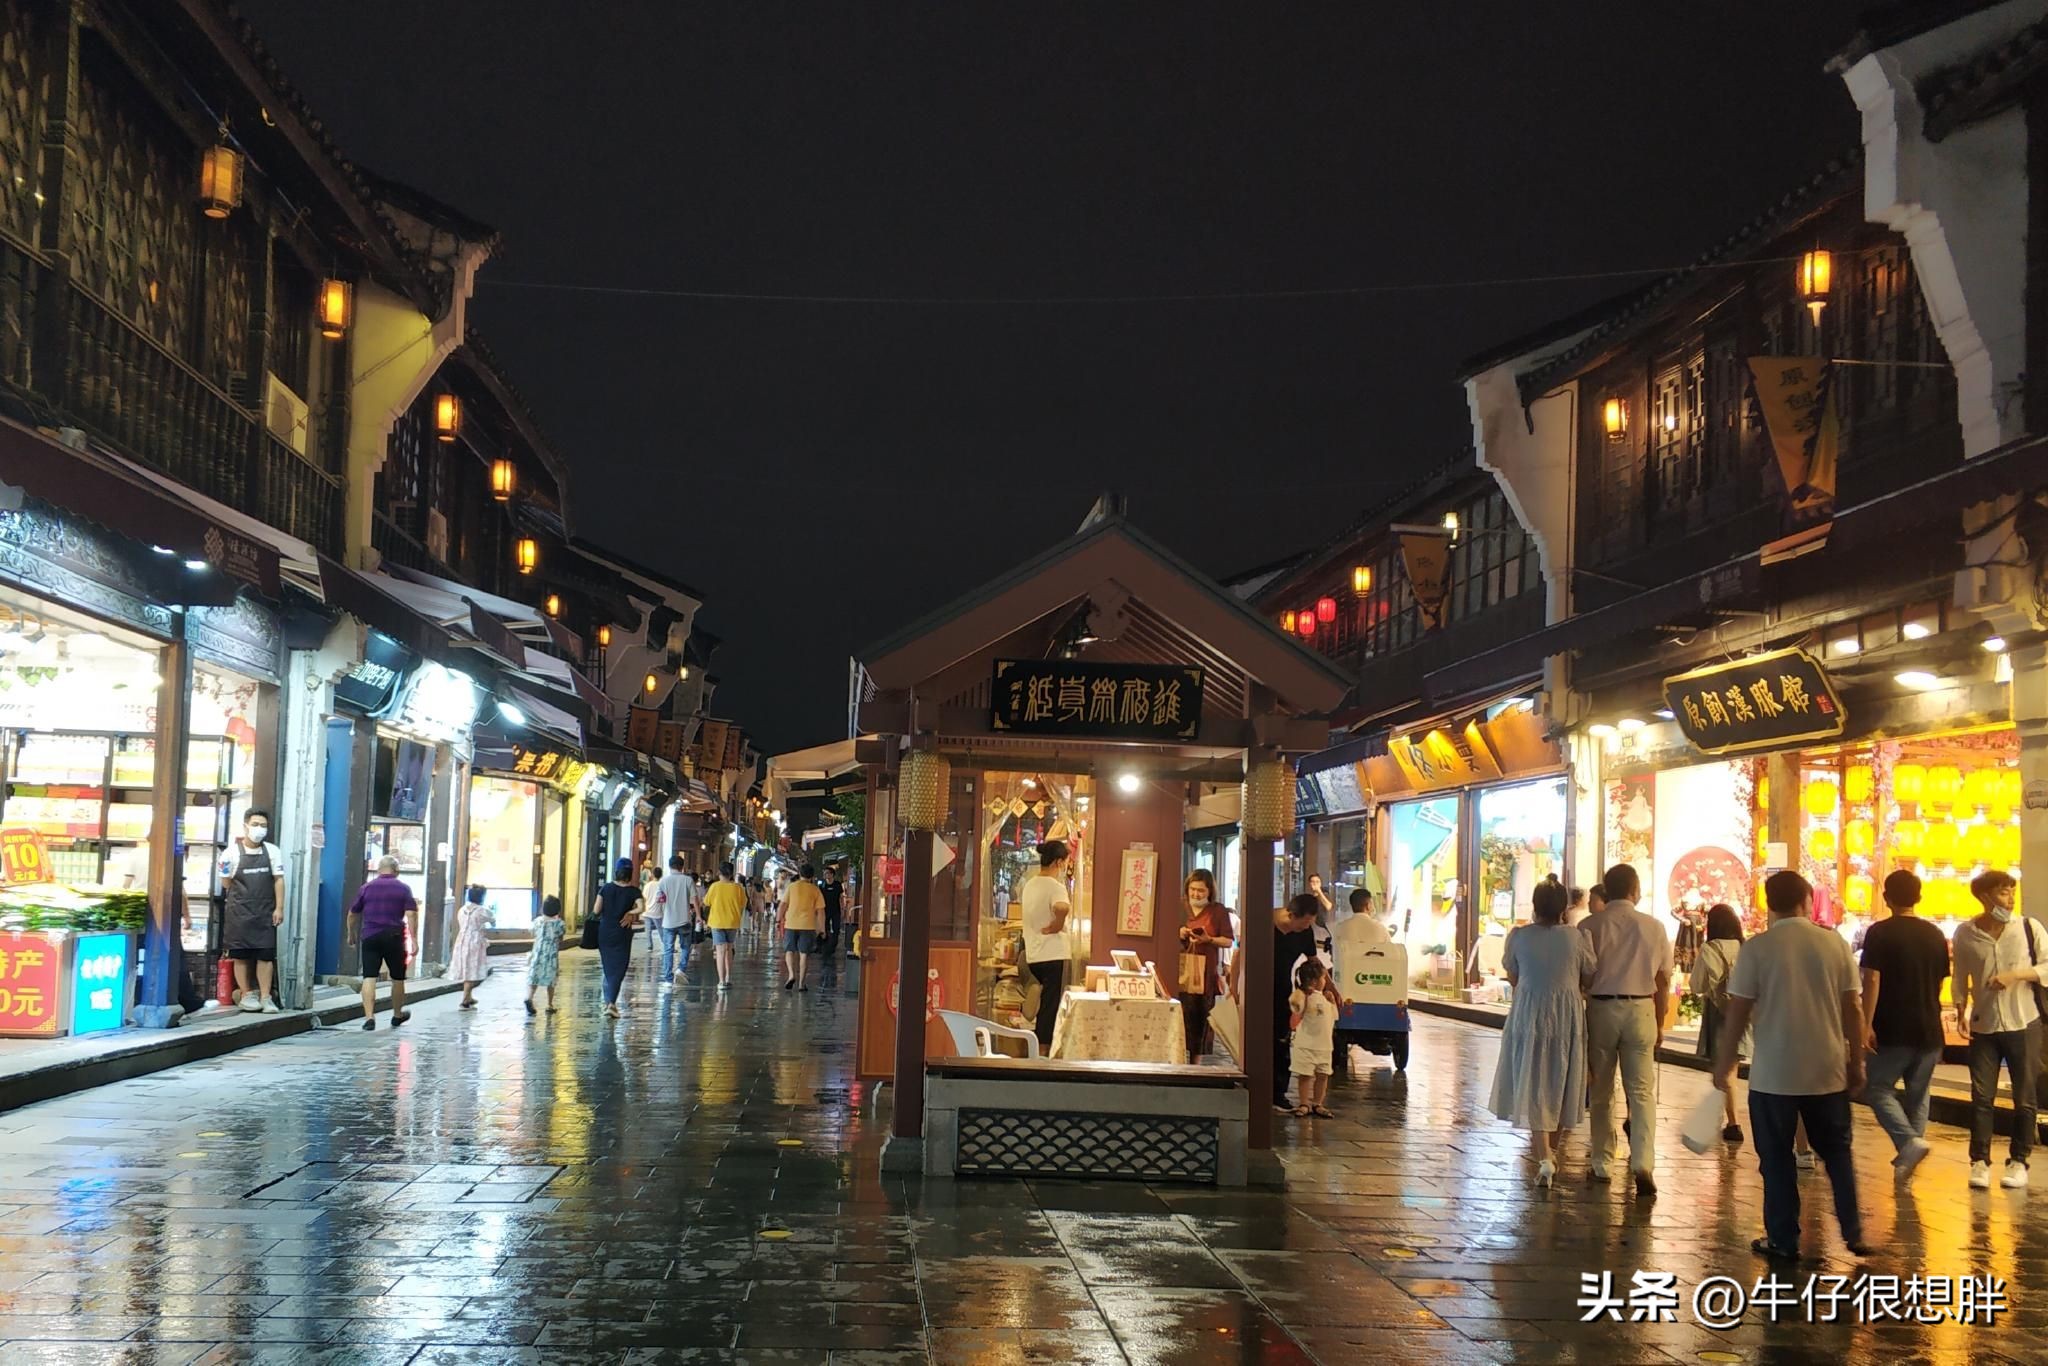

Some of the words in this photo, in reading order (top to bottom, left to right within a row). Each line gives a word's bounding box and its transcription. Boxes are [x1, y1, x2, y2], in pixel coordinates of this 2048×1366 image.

[1682, 674, 1811, 732] 原創漢服館
[3, 843, 38, 869] 10
[0, 947, 45, 980] 产
